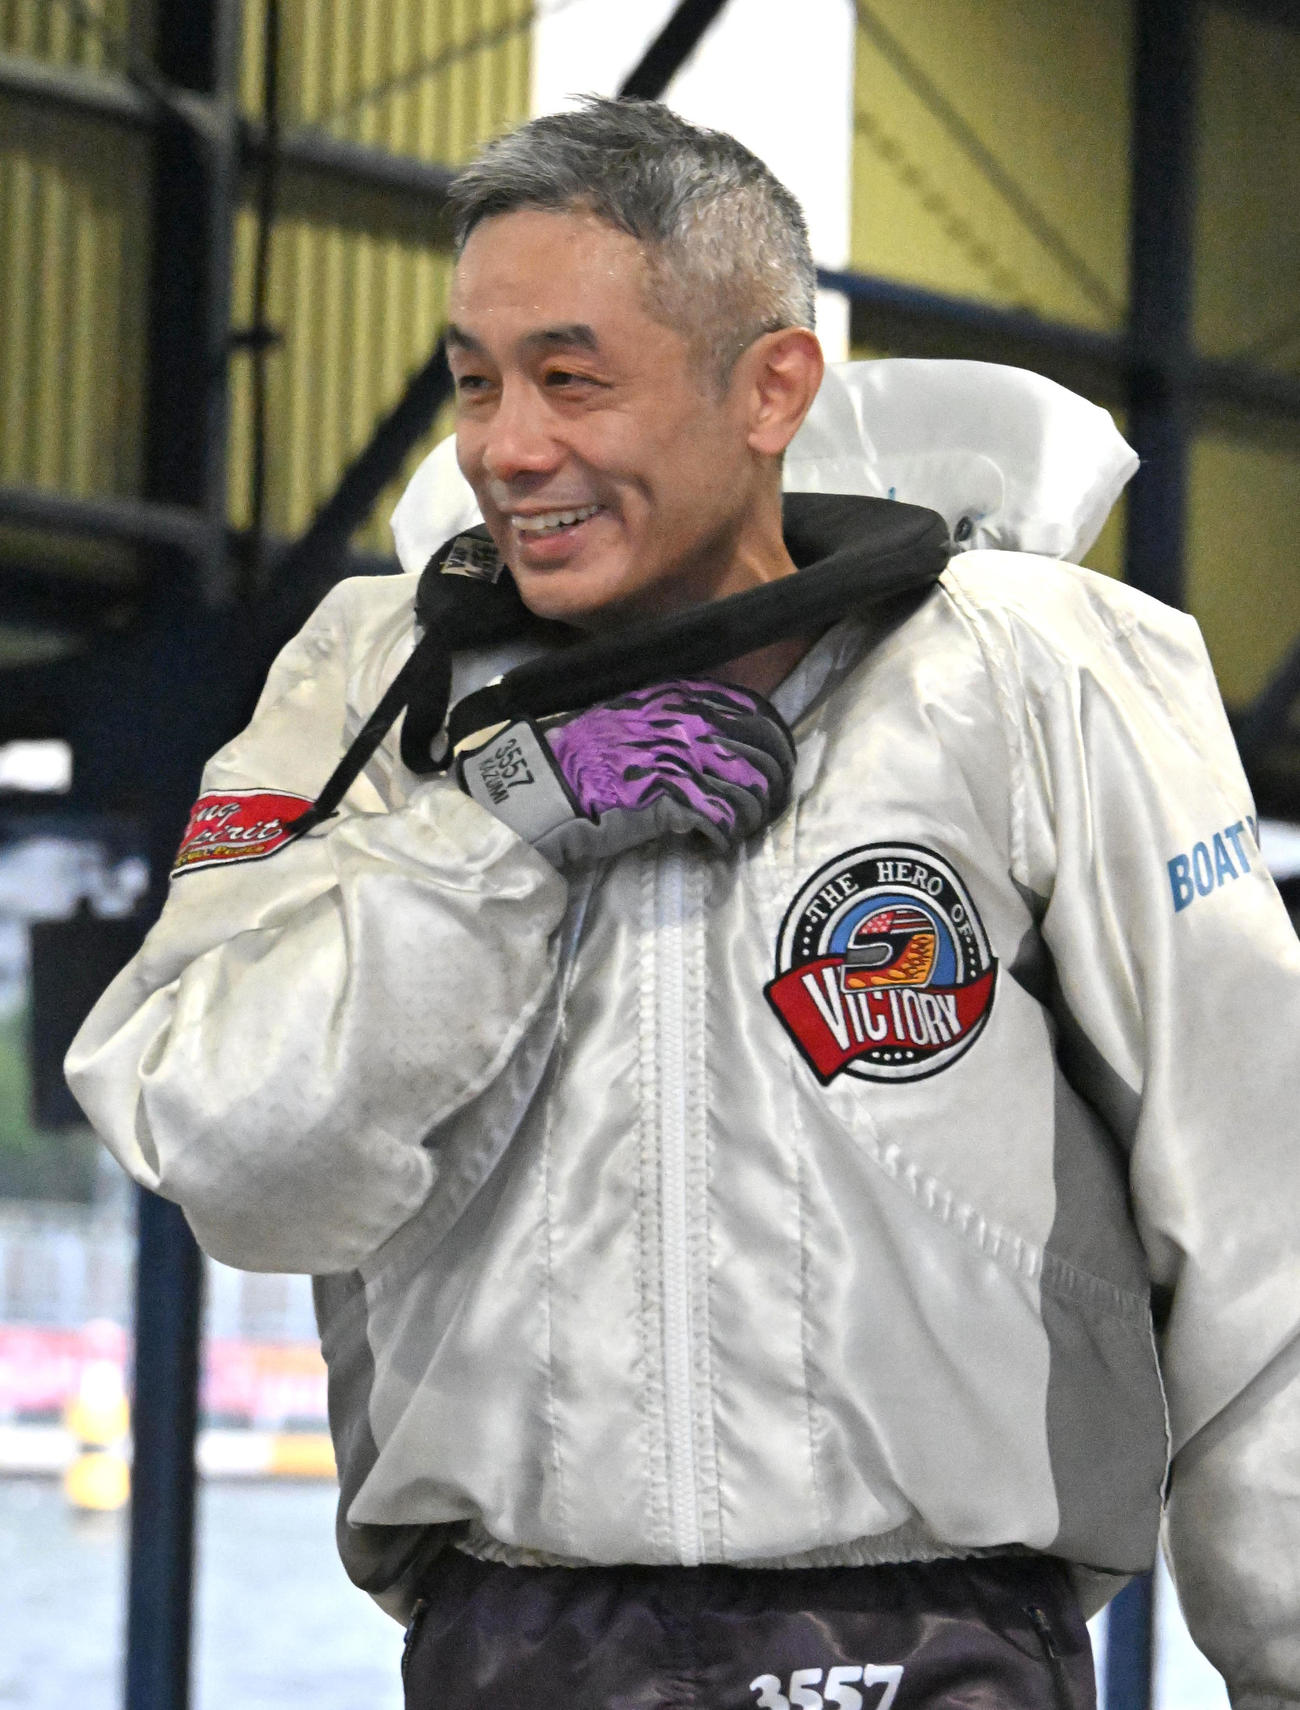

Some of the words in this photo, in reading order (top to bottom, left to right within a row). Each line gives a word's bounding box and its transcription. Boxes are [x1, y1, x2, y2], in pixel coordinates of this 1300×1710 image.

[495, 738, 535, 788] 3557
[805, 873, 860, 919] THE
[876, 861, 944, 896] HERO
[951, 904, 974, 936] OF
[801, 966, 962, 1050] VICTORY
[749, 1664, 904, 1710] 3557
